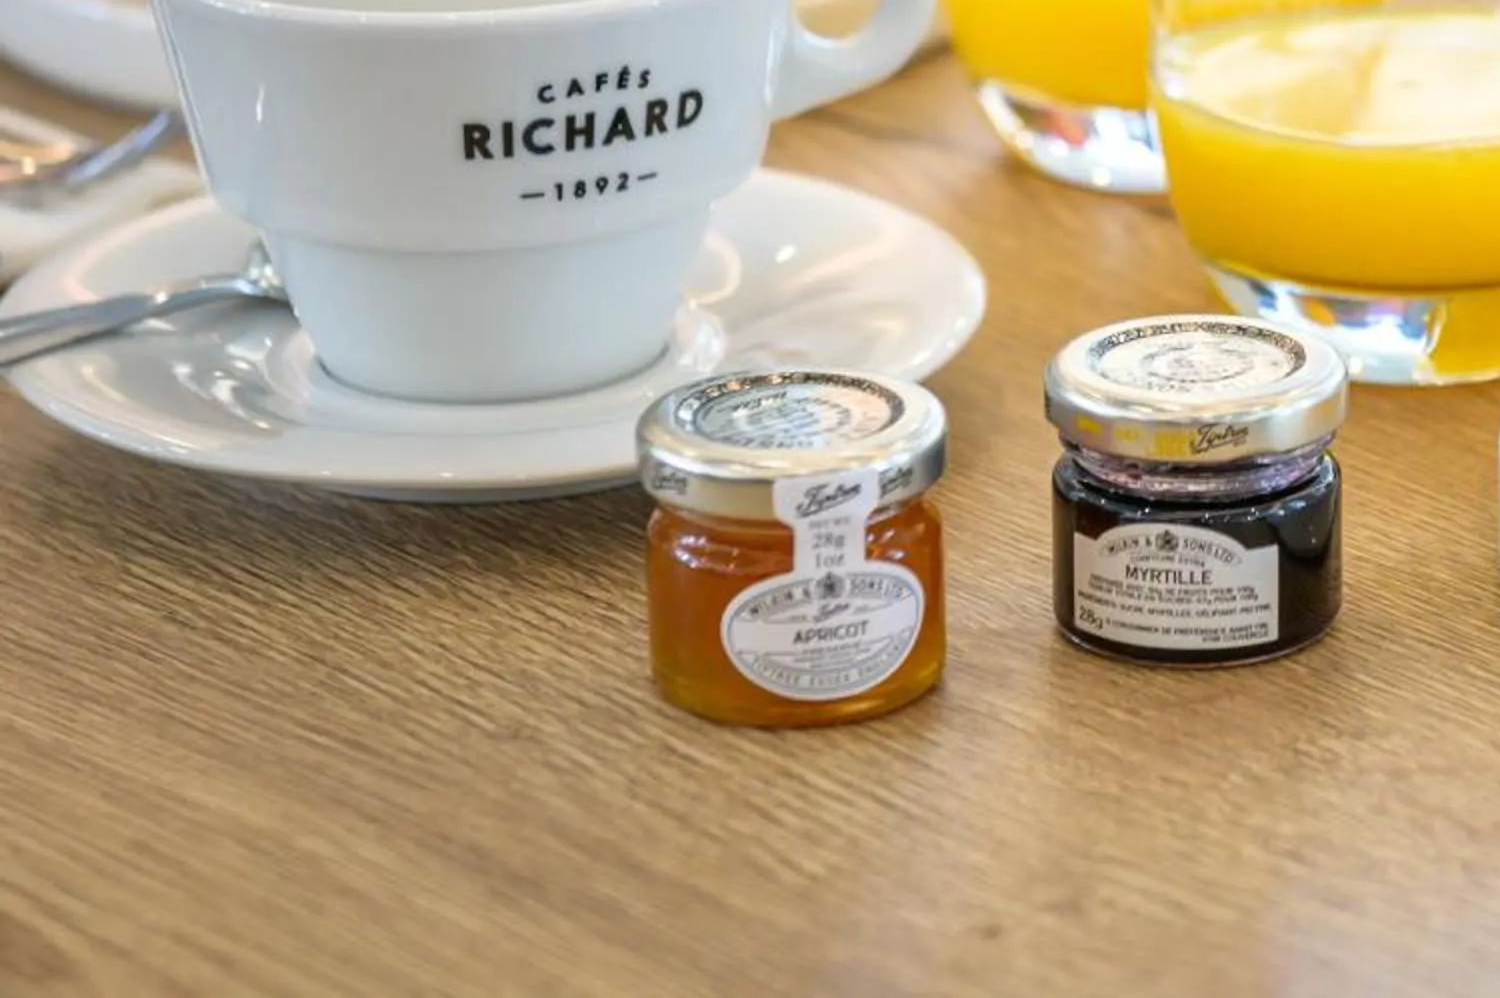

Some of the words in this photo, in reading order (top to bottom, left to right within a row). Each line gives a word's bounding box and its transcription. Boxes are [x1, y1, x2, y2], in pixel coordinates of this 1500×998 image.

[537, 65, 651, 103] CAFÉS
[463, 90, 703, 160] RICHARD
[812, 532, 846, 549] 28g
[1125, 564, 1213, 585] MYRTILLE
[1080, 605, 1103, 630] 28g
[793, 620, 869, 645] APRICOT
